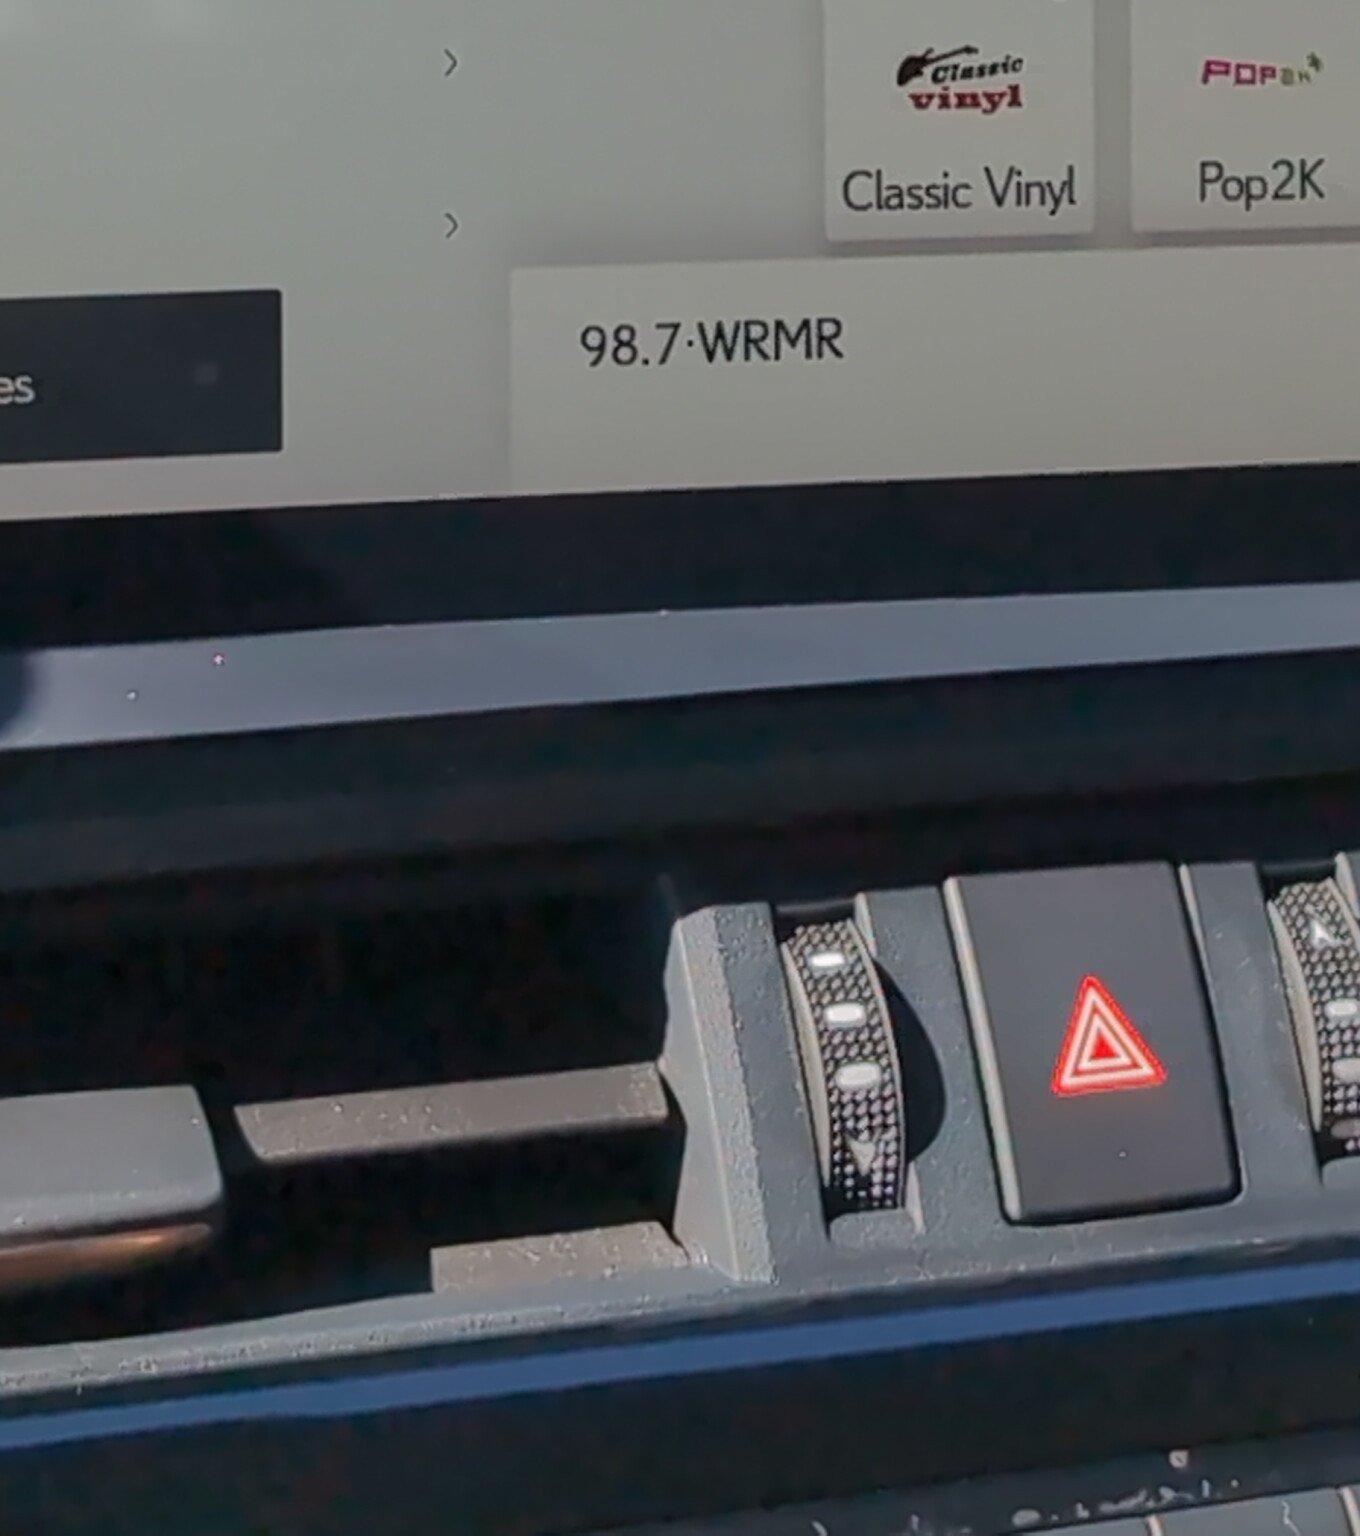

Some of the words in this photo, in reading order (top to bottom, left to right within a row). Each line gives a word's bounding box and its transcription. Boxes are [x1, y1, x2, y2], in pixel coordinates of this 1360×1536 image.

[908, 83, 1023, 115] vinyl
[842, 168, 973, 212] Classic
[983, 164, 1077, 217] Vinyl
[1199, 158, 1325, 205] Pop2K
